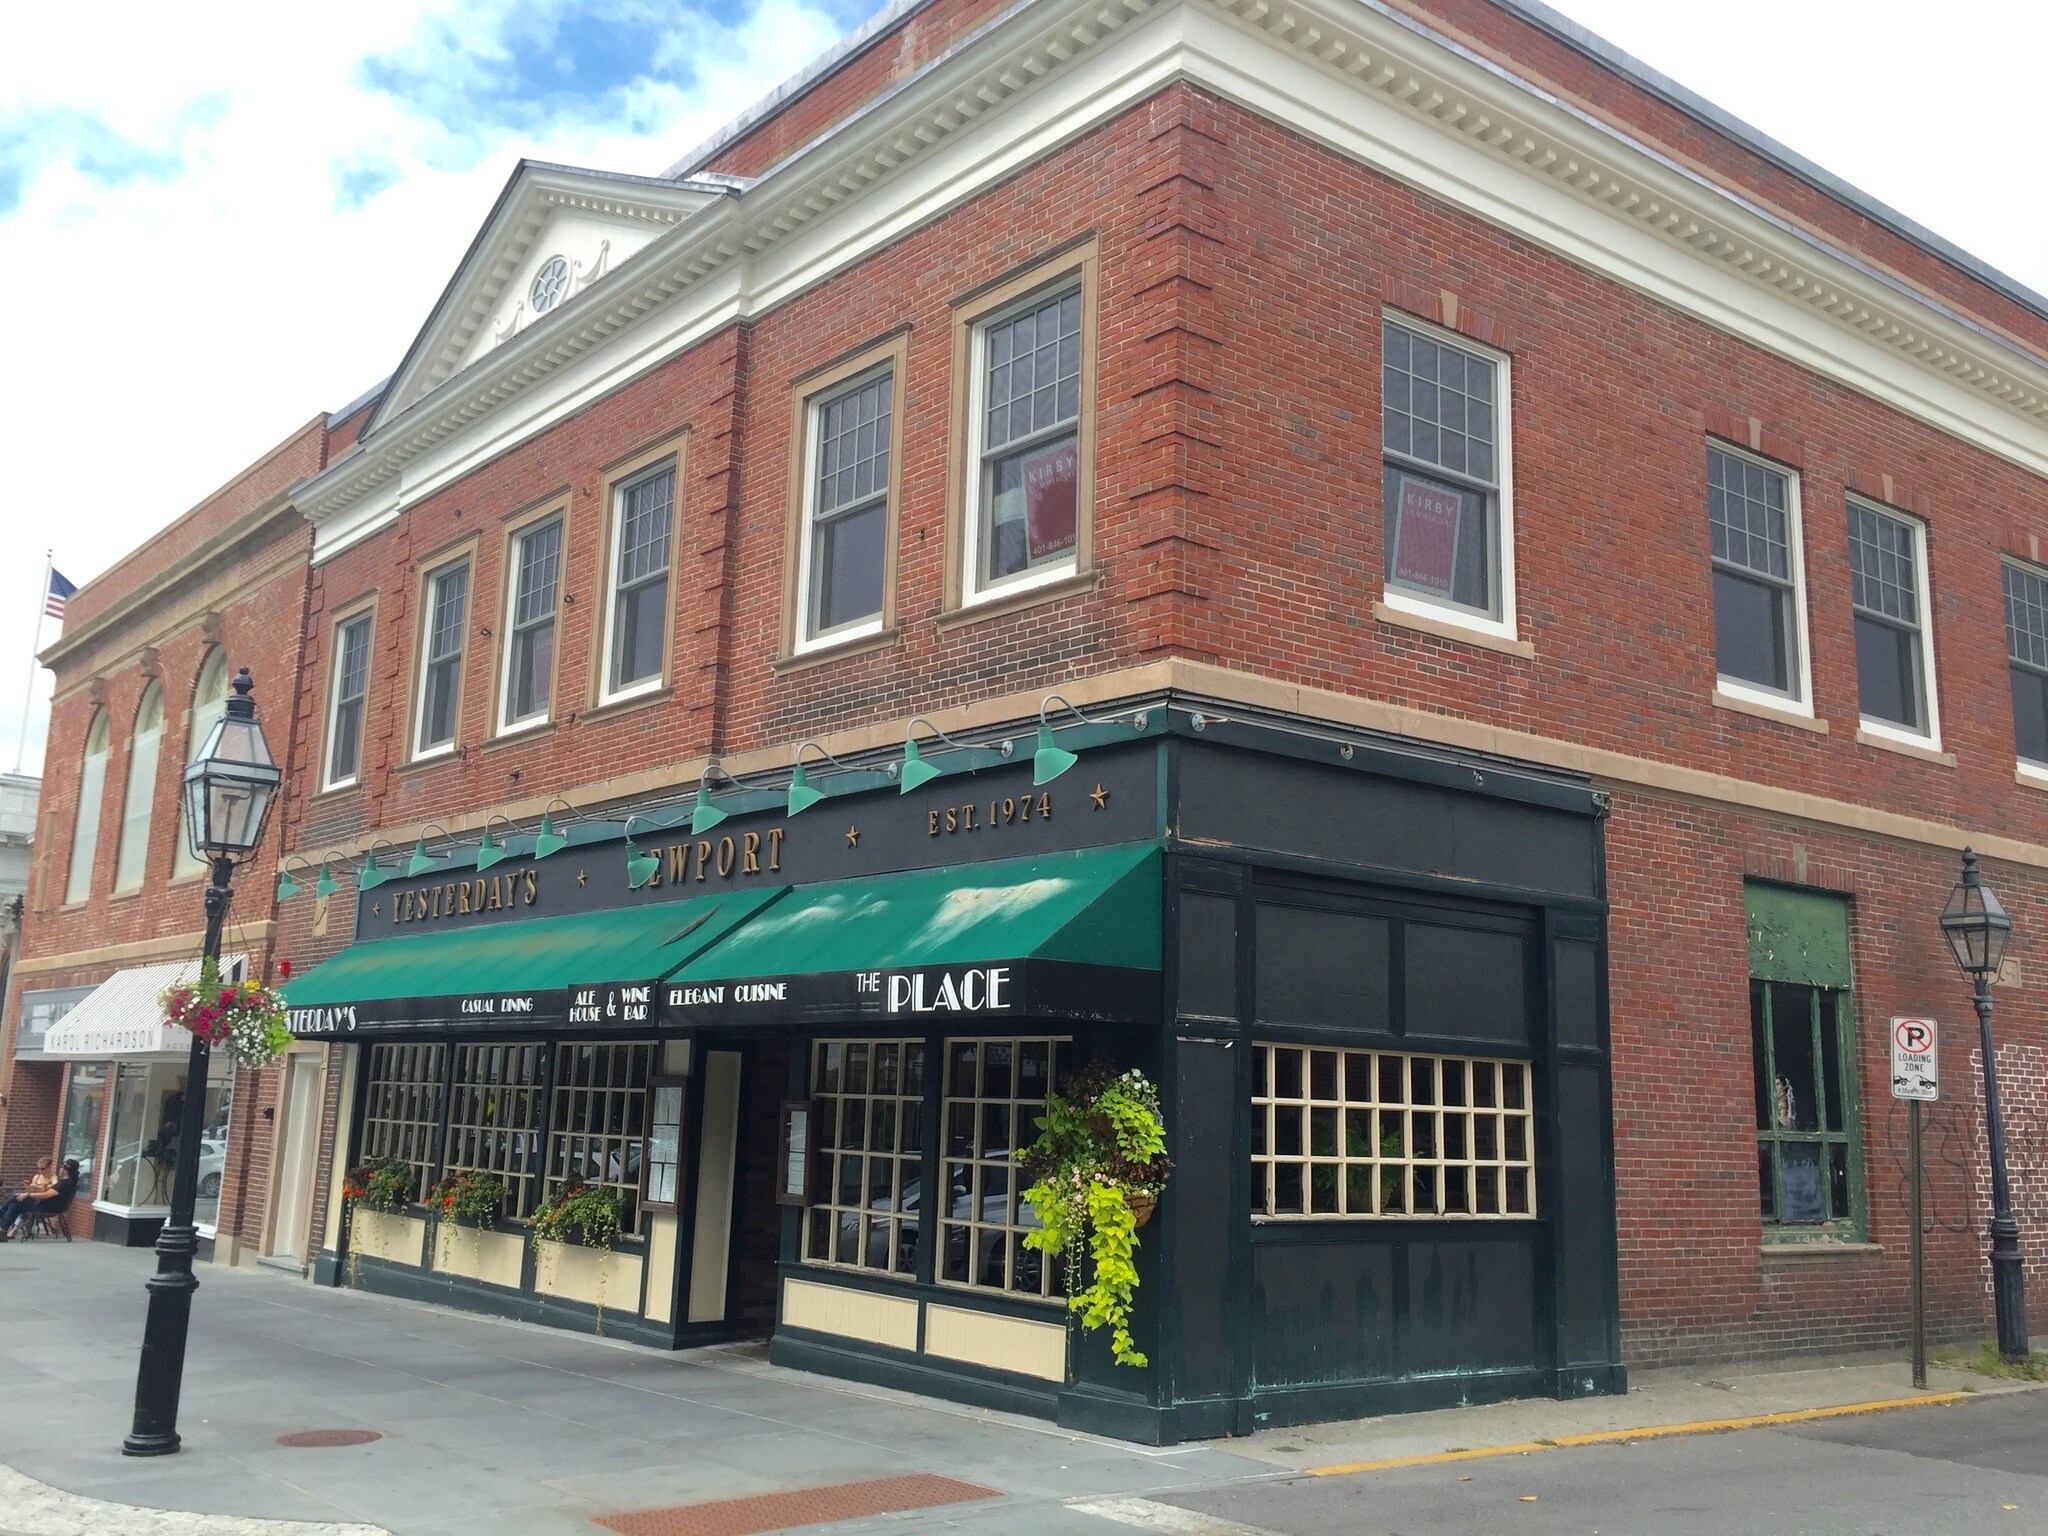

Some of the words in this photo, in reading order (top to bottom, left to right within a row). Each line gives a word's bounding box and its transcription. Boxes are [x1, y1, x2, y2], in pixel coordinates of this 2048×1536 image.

[1028, 455, 1074, 483] KIRBY
[1407, 492, 1453, 517] KIRBY
[1033, 534, 1076, 555] 401-846-101
[1399, 567, 1448, 588] 401-846-1010
[928, 804, 980, 836] EST.
[989, 791, 1051, 825] 1974
[628, 828, 785, 889] EWPORT
[393, 868, 538, 924] YESTERDAY'S
[574, 990, 596, 1006] ALE
[621, 986, 651, 1003] WINE
[669, 986, 726, 1006] ELEGANT
[734, 982, 788, 1003] CUISINE
[856, 972, 881, 993] THE
[887, 967, 1011, 1013] PLACE
[461, 998, 495, 1013] CASUAL
[501, 997, 534, 1013] DINING
[569, 1006, 601, 1022] HOUSE
[606, 991, 617, 1017] &
[623, 1004, 649, 1021] BAR
[284, 1006, 357, 1033] STERDAY'S
[50, 1034, 80, 1050] KAROL
[85, 1029, 154, 1049] RICHARDSON
[1898, 1053, 1932, 1063] LOADING
[1904, 1063, 1924, 1072] ZONE
